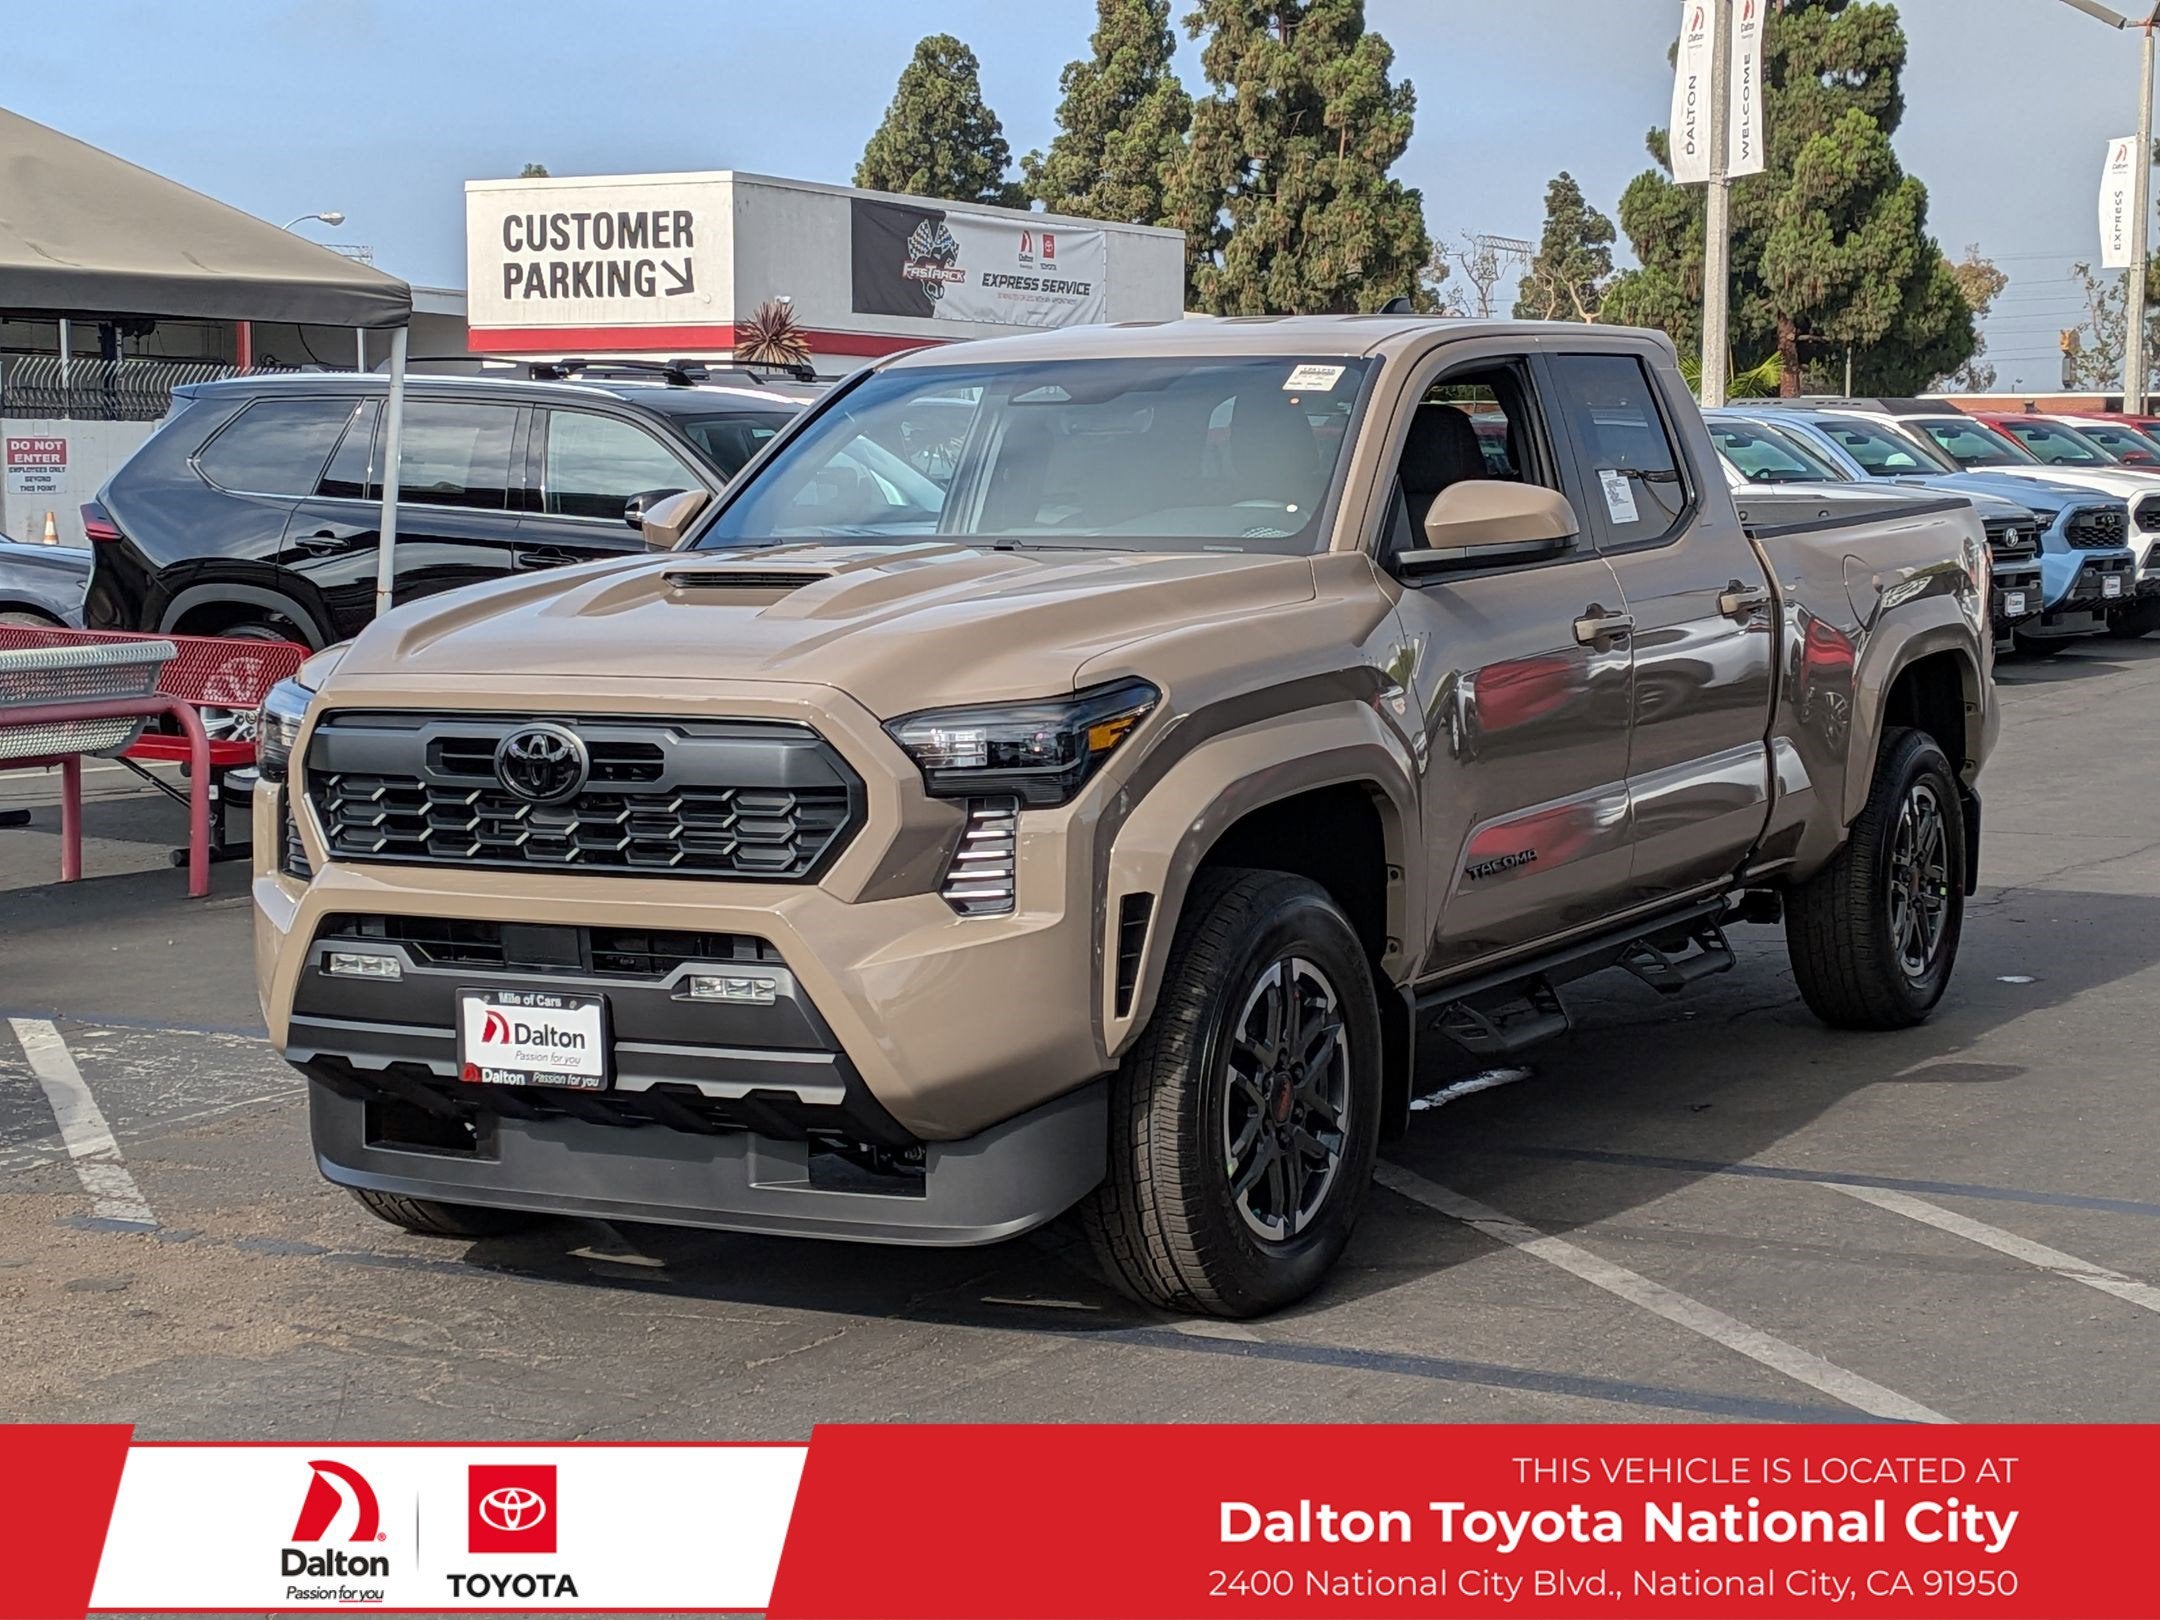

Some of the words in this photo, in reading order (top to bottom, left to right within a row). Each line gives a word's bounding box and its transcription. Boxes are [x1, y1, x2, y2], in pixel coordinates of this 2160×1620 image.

[1686, 75, 1697, 155] DALTON
[1742, 53, 1751, 160] WELCOME
[503, 210, 694, 252] CUSTOMER
[503, 259, 657, 300] PARKING
[981, 272, 1040, 291] EXPRESS
[1041, 278, 1091, 296] SERVICE
[11, 440, 30, 451] DO
[34, 440, 63, 451] NOT
[14, 453, 60, 463] ENTER
[1465, 848, 1538, 881] TACOMA
[498, 992, 521, 1005] Mile
[523, 994, 536, 1006] of
[536, 995, 562, 1008] Cars
[514, 1023, 586, 1050] Dalton
[514, 1050, 549, 1063] Passion
[549, 1051, 564, 1064] for
[564, 1056, 582, 1066] you
[482, 1068, 526, 1086] Dalton
[532, 1072, 566, 1085] Passion
[567, 1073, 582, 1087] for
[581, 1078, 600, 1088] you
